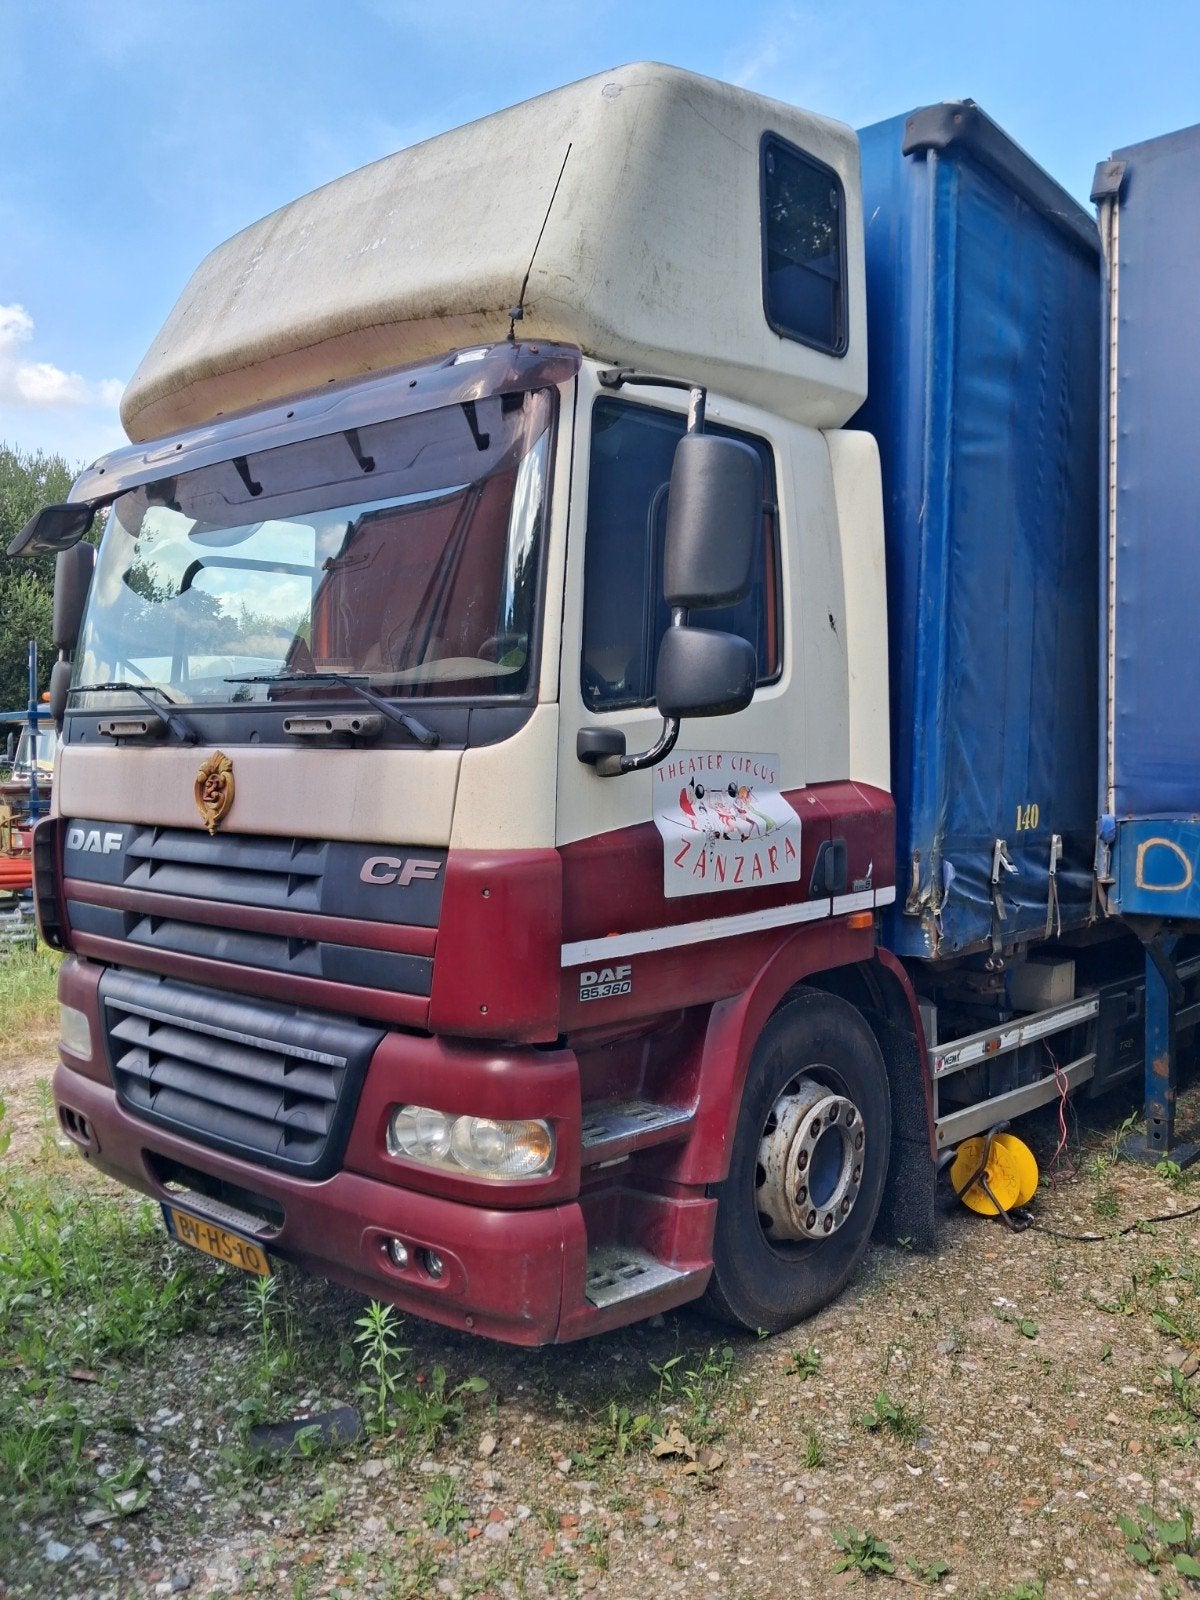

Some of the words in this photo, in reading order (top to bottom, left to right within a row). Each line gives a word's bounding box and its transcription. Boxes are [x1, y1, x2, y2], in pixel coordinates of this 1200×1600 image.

[657, 754, 723, 783] THEATER
[731, 755, 776, 784] CIRCUS
[1015, 802, 1040, 832] 140
[66, 828, 123, 855] DAF
[359, 856, 442, 886] CF
[673, 836, 797, 883] ZANZARA
[580, 964, 632, 986] DAF
[580, 981, 631, 1000] 85.360
[177, 1214, 261, 1270] BV-HS-10
